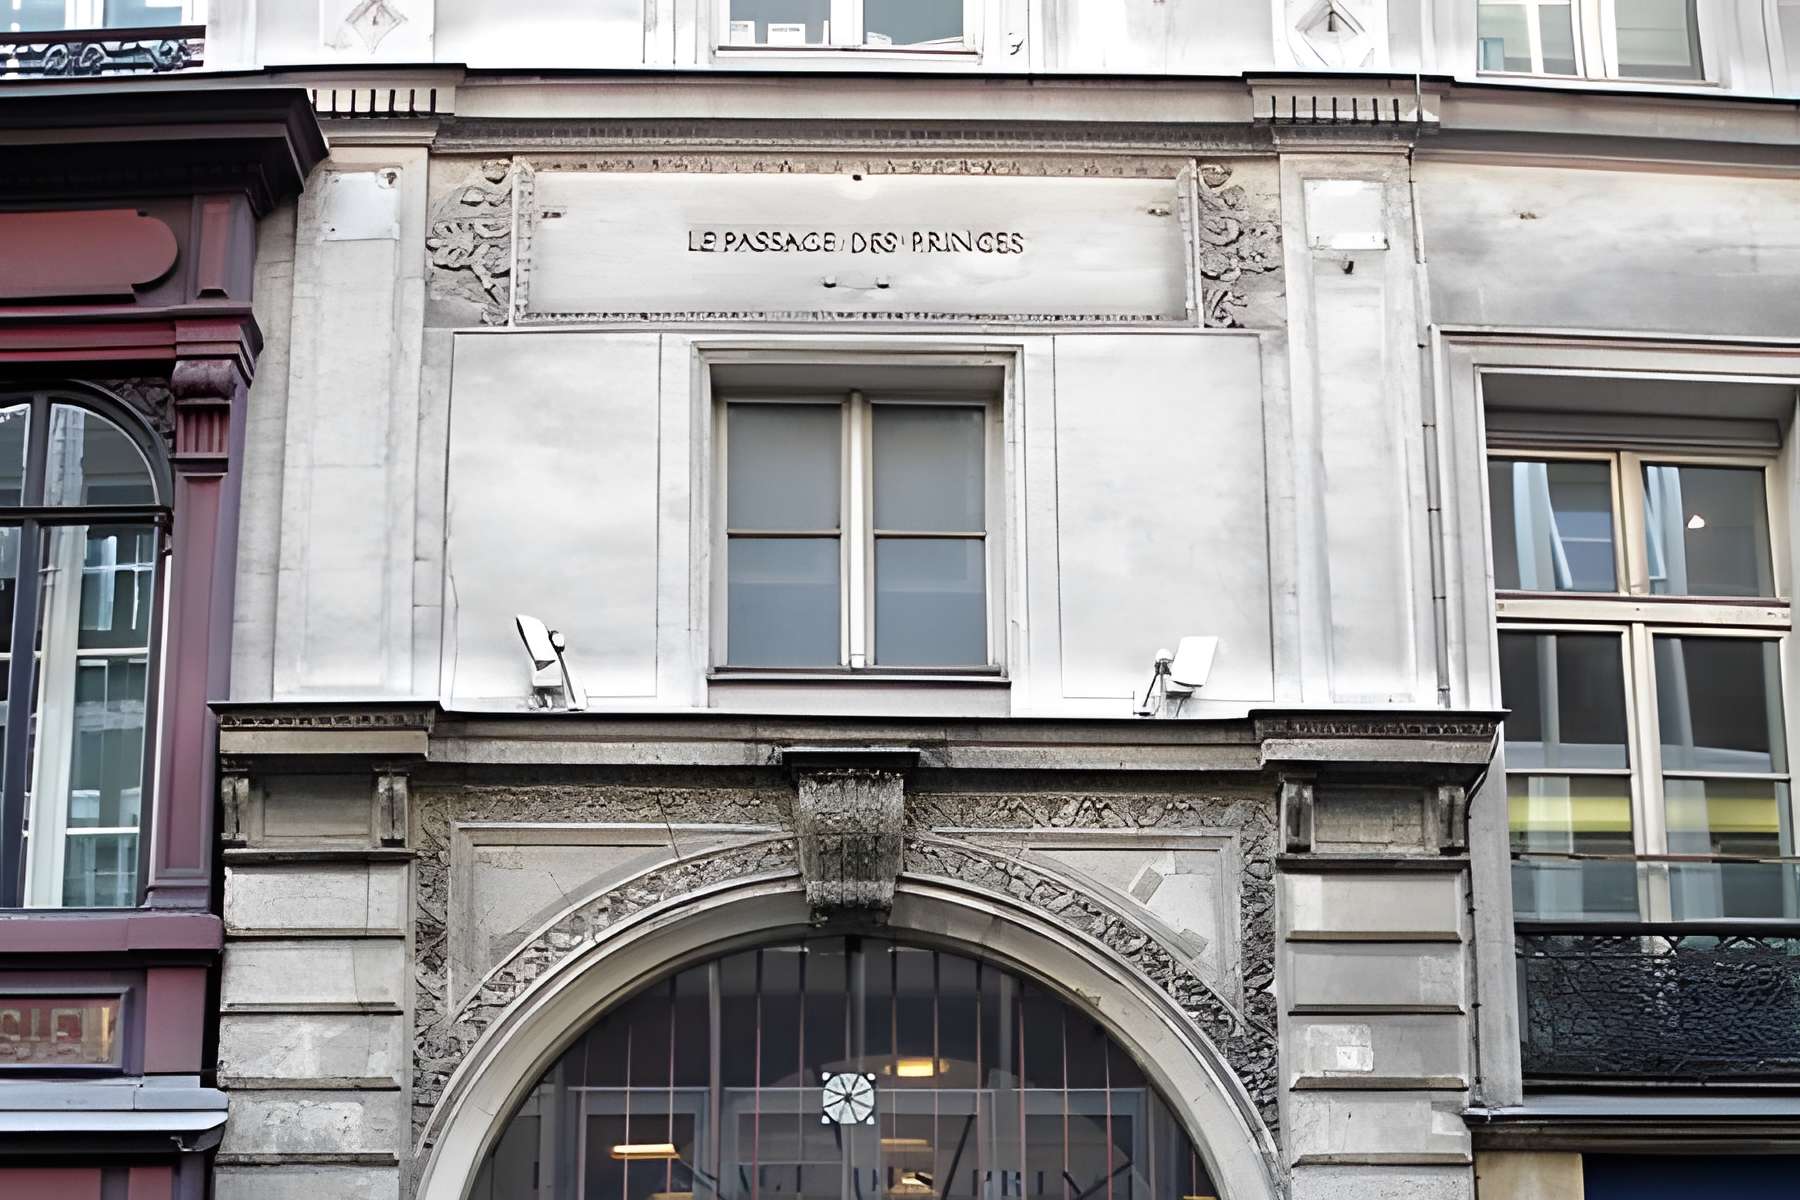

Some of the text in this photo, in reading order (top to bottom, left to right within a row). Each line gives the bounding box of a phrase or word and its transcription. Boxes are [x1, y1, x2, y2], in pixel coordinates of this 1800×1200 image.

[687, 230, 718, 252] LE
[723, 230, 837, 253] PASSAGE
[911, 230, 1025, 254] PRINCES
